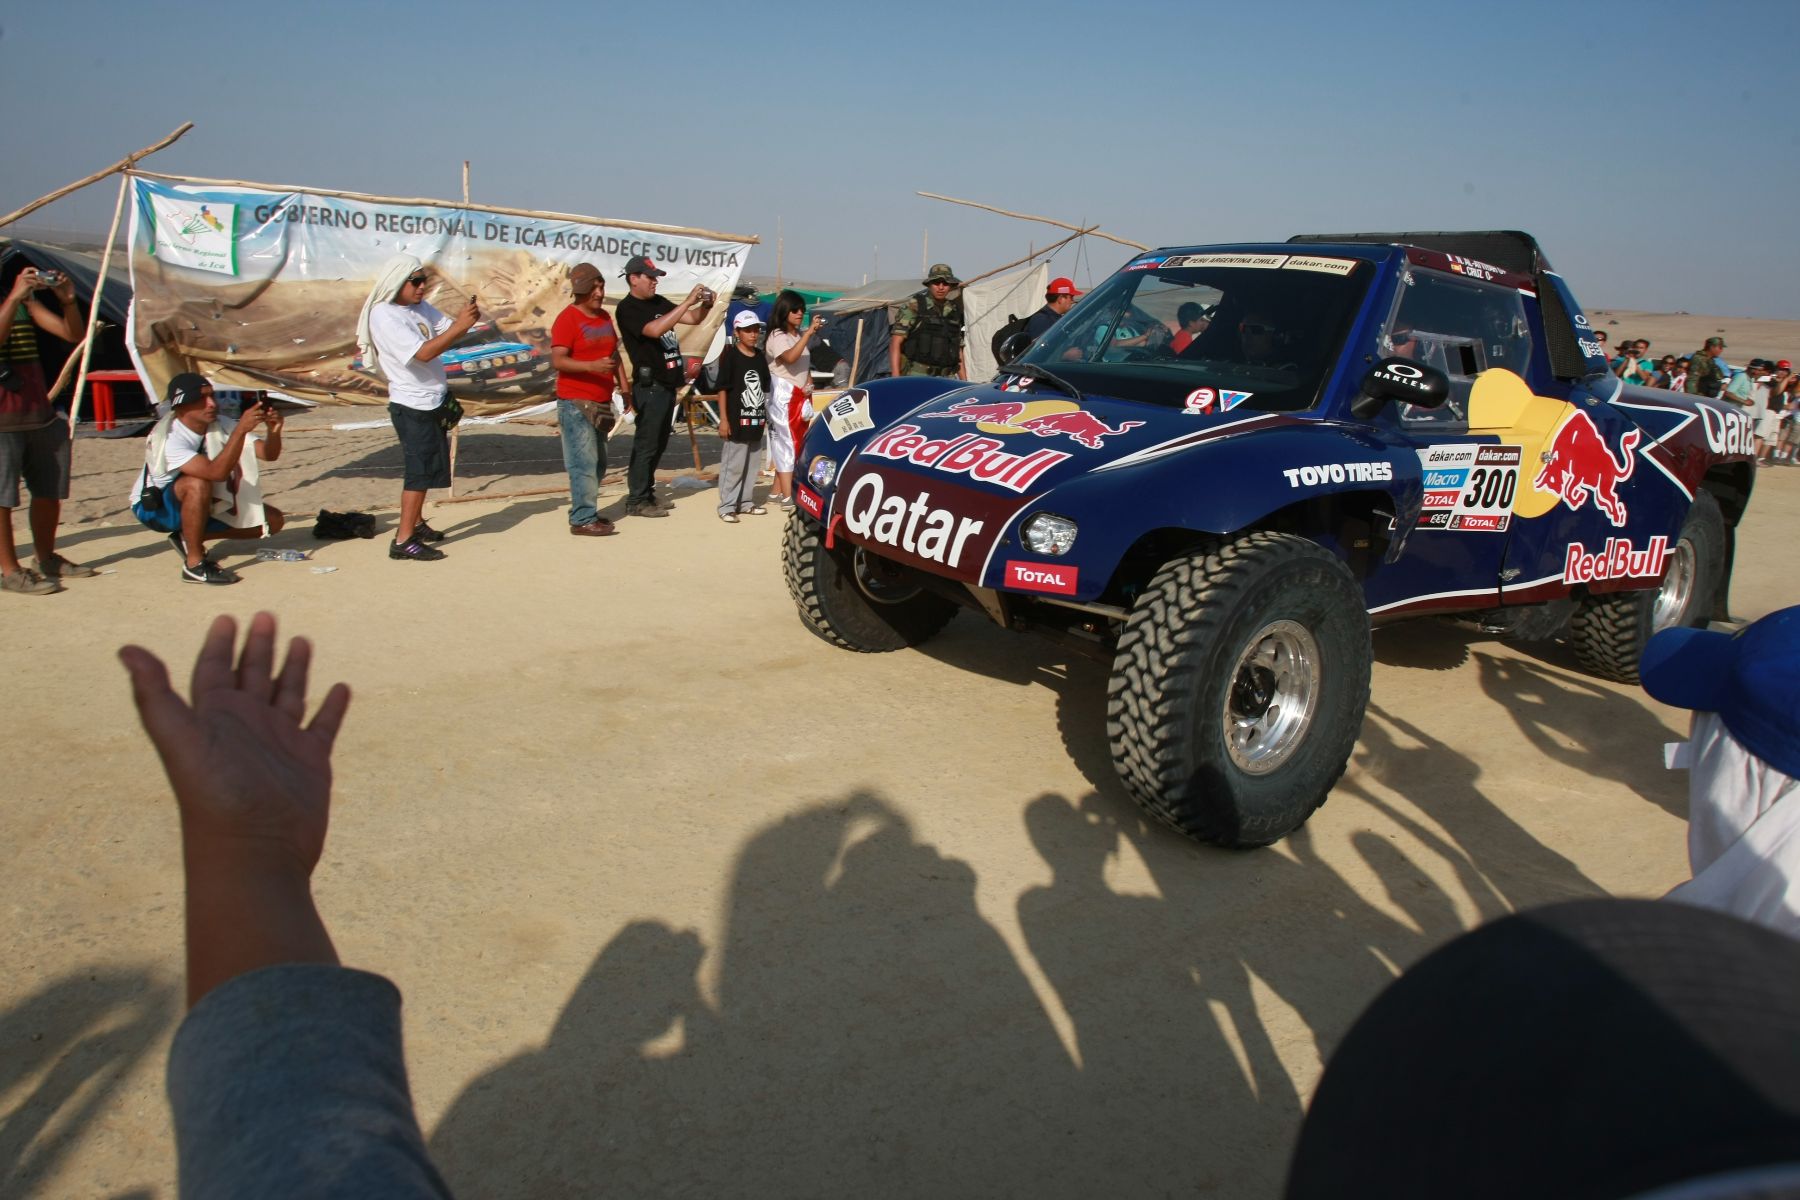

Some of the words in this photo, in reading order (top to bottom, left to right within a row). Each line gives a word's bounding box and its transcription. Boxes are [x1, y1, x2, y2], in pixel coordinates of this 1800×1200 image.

[254, 205, 367, 231] GOBIERNO
[375, 213, 478, 239] REGIONAL
[485, 222, 508, 243] DE
[515, 227, 547, 248] ICA
[553, 231, 650, 259] AGRADECE
[656, 244, 679, 263] SU
[685, 248, 738, 268] VISITA
[1188, 257, 1209, 265] PERU
[1209, 256, 1252, 265] ARGENTINA
[1252, 257, 1279, 265] CHILE
[1289, 259, 1349, 271] dakar.com
[1374, 371, 1431, 391] OAKLEY
[833, 398, 855, 416] 300
[1694, 402, 1755, 457] Qata
[1428, 450, 1473, 462] dakar.com
[1478, 449, 1519, 461] dakar.com
[1282, 463, 1346, 488] TOYO
[1343, 461, 1393, 482] TIRES
[1423, 472, 1460, 486] Macro
[1463, 468, 1517, 509] 300
[800, 489, 818, 512] TOTAL
[1422, 493, 1456, 505] TOTAL
[844, 472, 984, 568] Qatar
[1464, 516, 1495, 527] TOTAL
[1014, 566, 1066, 586] TOTAL
